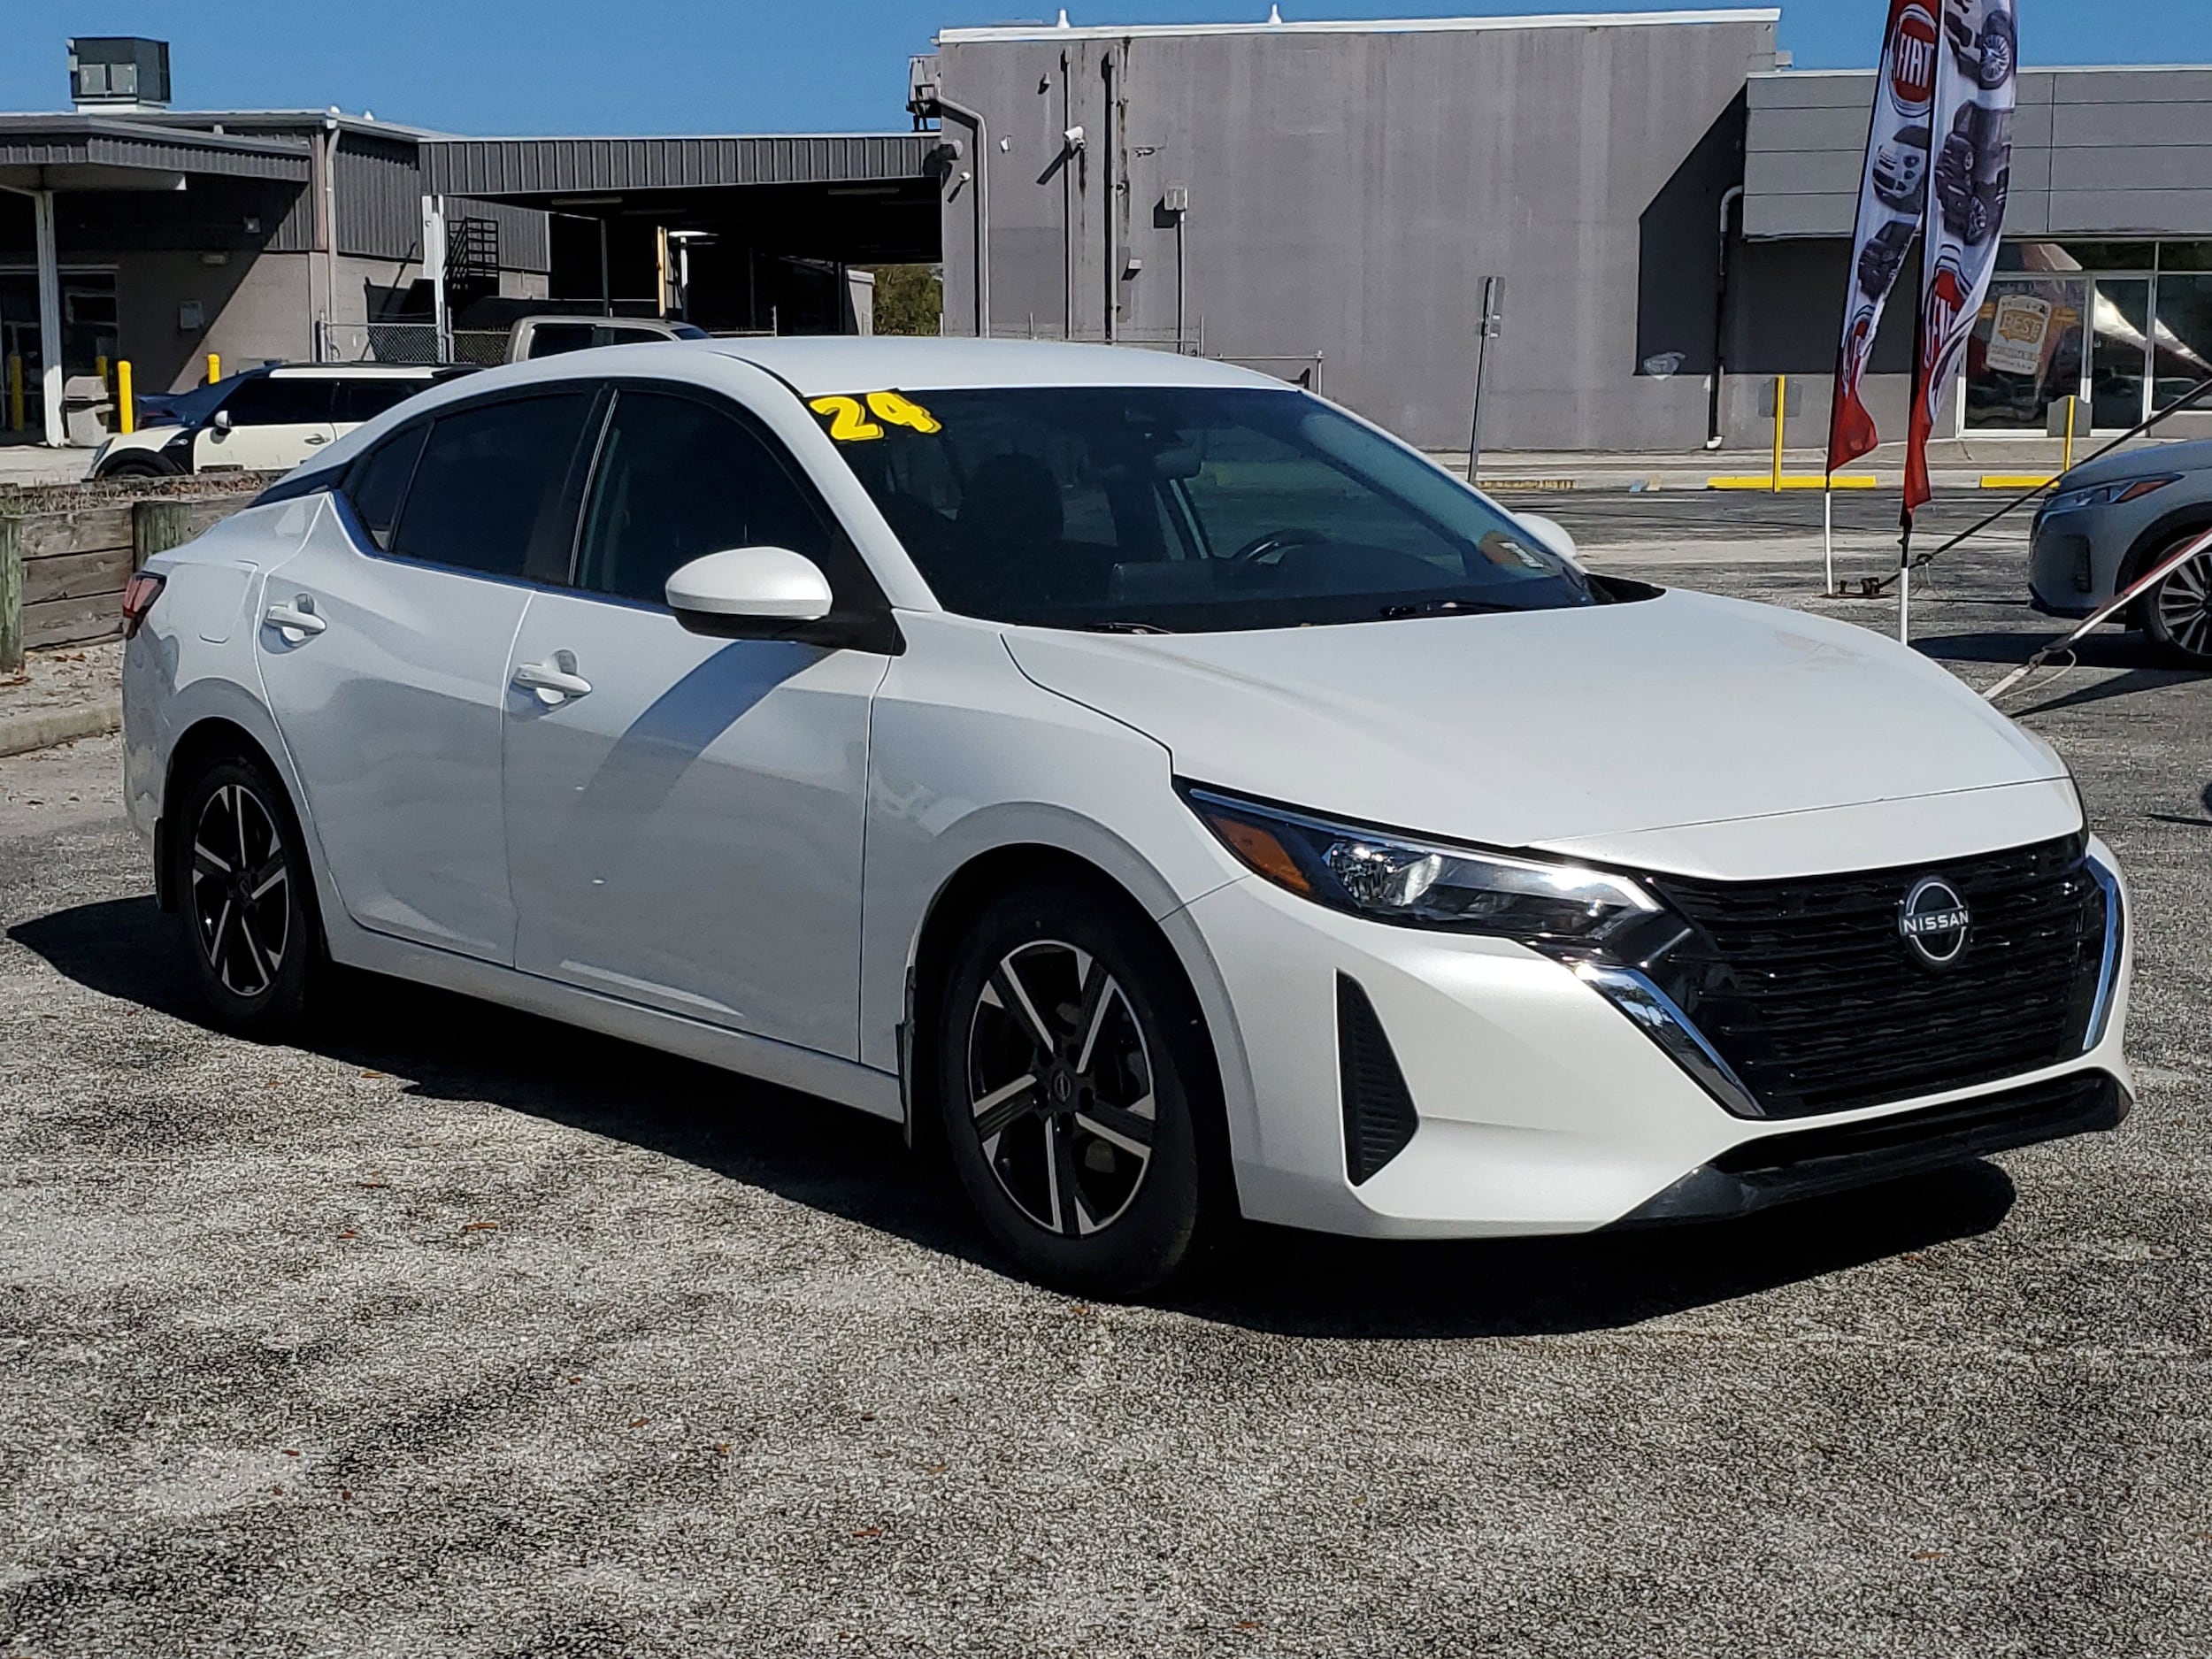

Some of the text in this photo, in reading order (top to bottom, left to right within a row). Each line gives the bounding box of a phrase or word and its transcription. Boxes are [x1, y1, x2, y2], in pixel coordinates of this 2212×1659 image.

[1896, 32, 1935, 88] FIAT
[809, 392, 942, 442] 24
[1903, 910, 1969, 933] NISSAN
